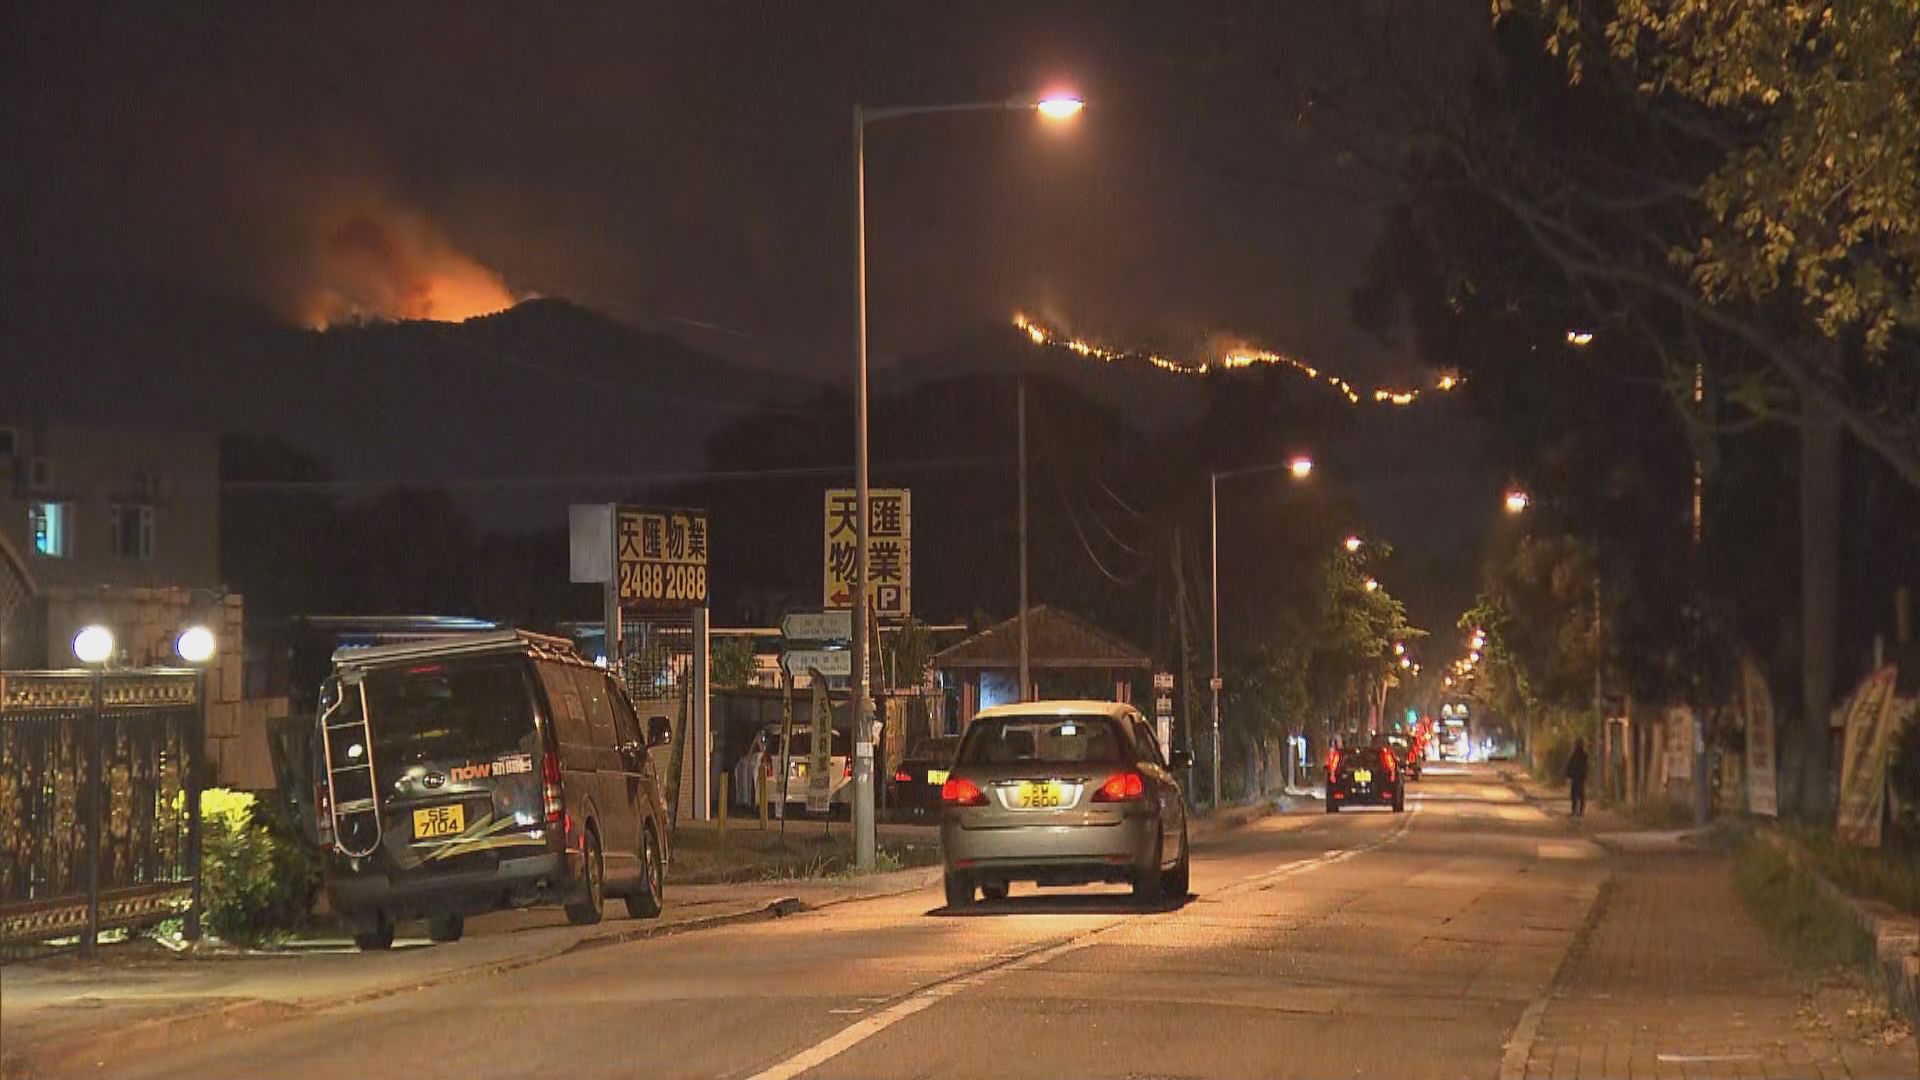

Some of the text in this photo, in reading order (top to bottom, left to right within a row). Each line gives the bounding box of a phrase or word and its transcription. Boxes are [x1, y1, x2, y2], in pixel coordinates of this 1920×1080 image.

[829, 496, 902, 538] 天匯
[619, 515, 706, 560] 天匯物業
[829, 541, 902, 583] 物業
[620, 562, 707, 601] 2488 2088
[881, 587, 897, 609] P
[450, 762, 491, 784] now
[420, 818, 458, 835] 7104
[428, 808, 449, 822] SE
